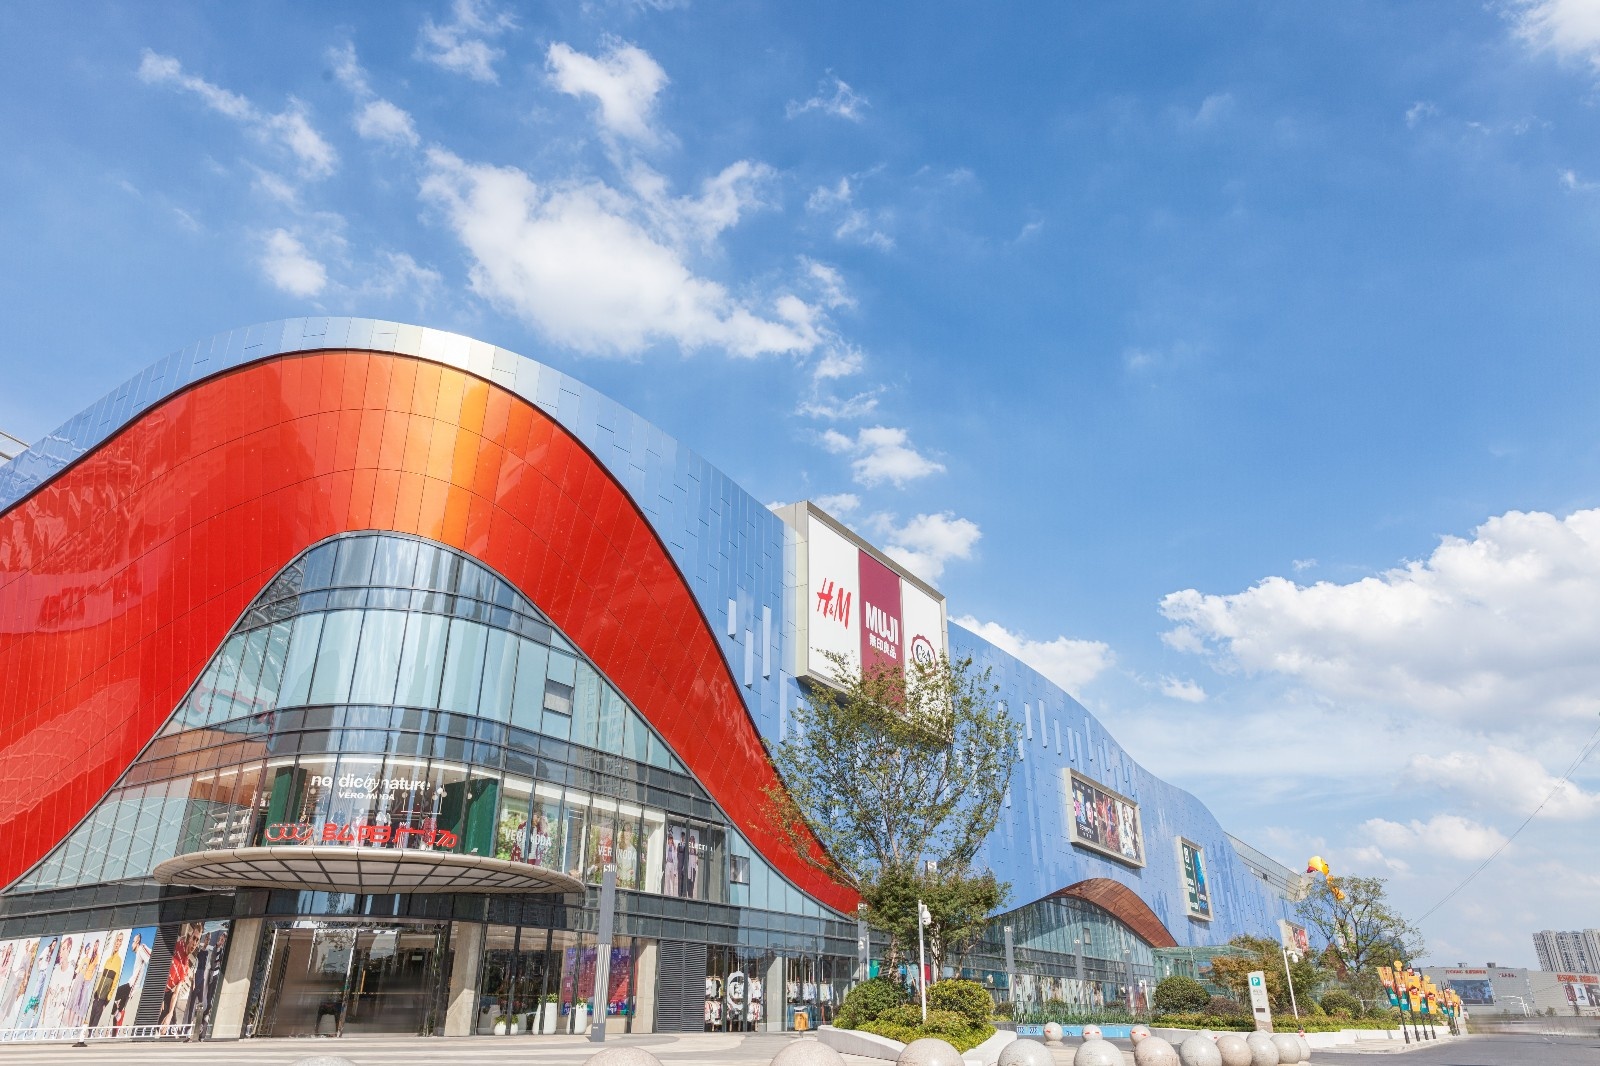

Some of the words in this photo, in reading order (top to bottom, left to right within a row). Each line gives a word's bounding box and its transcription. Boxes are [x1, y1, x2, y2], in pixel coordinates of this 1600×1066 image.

[817, 577, 852, 630] H&M
[865, 601, 899, 645] MUJI
[869, 633, 897, 660] 無印良品
